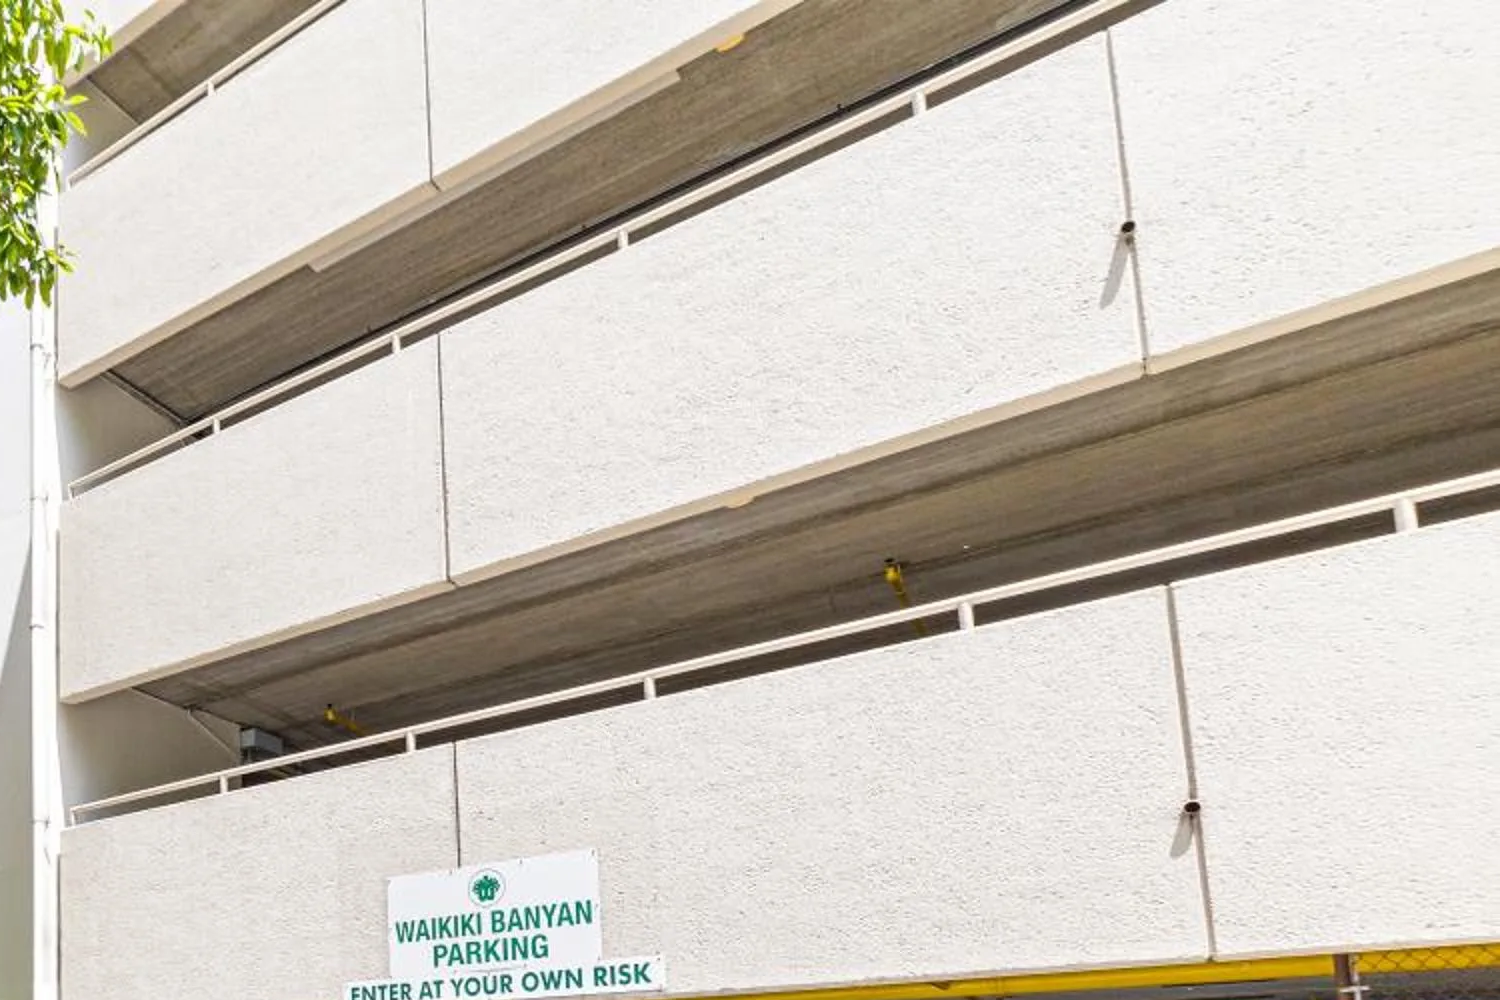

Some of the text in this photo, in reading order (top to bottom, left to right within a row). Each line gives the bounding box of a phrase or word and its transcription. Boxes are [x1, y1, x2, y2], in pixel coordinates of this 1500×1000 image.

[395, 900, 593, 944] WAIKIKI BANYAN
[433, 934, 549, 968] PARKING
[419, 980, 444, 1000] AT
[450, 974, 513, 996] YOUR
[521, 968, 583, 992] OWN
[593, 962, 651, 987] RISK
